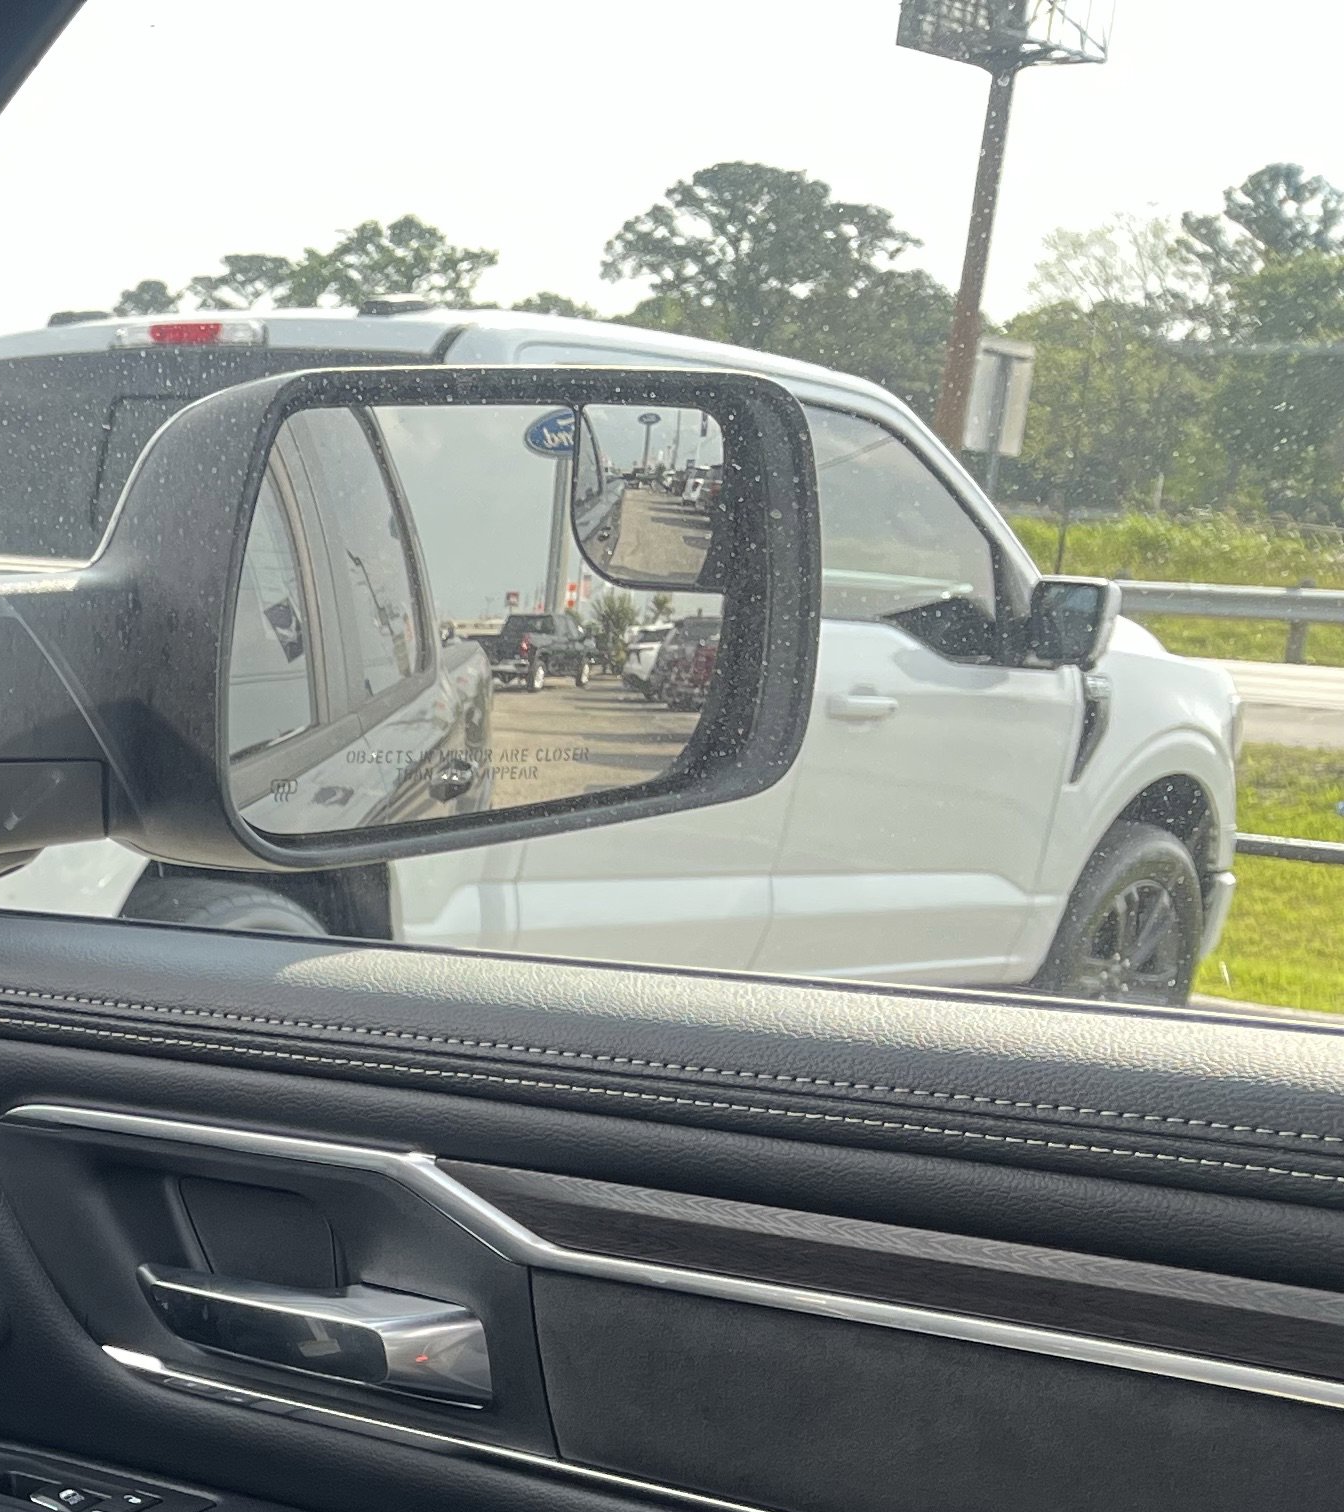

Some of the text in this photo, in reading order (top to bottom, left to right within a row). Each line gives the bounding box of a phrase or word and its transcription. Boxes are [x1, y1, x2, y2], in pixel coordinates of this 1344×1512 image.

[346, 749, 418, 765] OBJECTS
[439, 748, 493, 763] MIRROR
[499, 748, 529, 762] ARE
[535, 747, 590, 763] CLOSER
